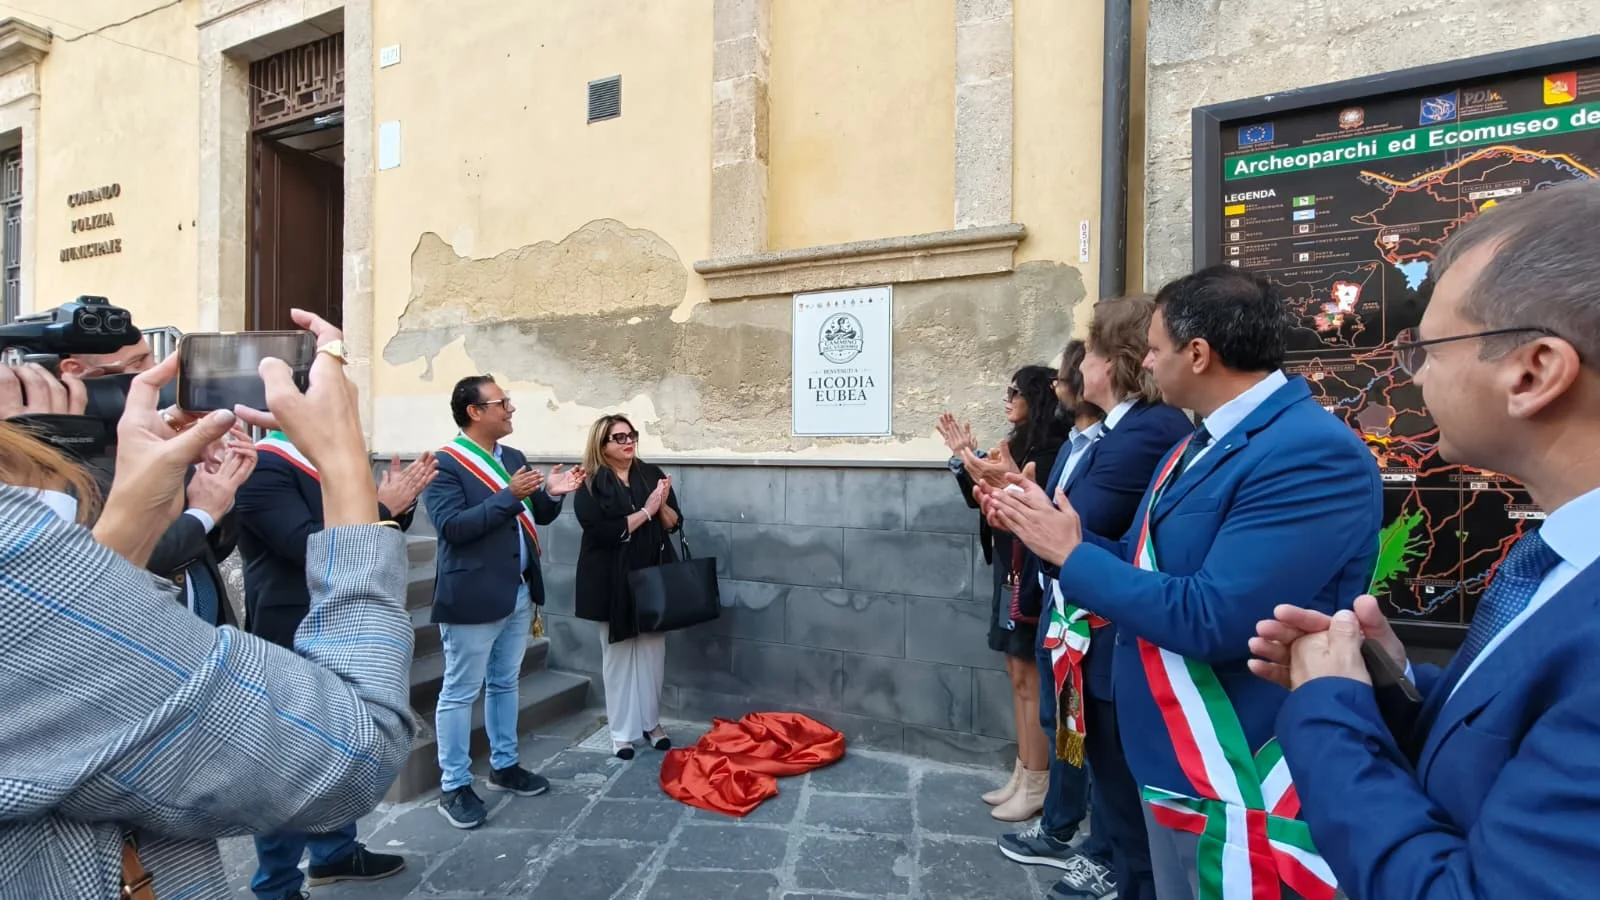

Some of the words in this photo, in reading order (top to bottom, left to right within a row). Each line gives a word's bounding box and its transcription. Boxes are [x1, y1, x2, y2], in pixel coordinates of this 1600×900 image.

[1233, 140, 1377, 176] Archeoparchi
[1388, 133, 1416, 152] ed
[1428, 117, 1558, 148] Ecomuseo
[67, 183, 121, 208] COMANDO
[1224, 188, 1276, 203] LEGENDA
[71, 212, 115, 234] POLIZIA
[59, 238, 122, 263] MUNICIPALE
[808, 376, 874, 390] LICODIA
[816, 389, 867, 402] EUBEA
